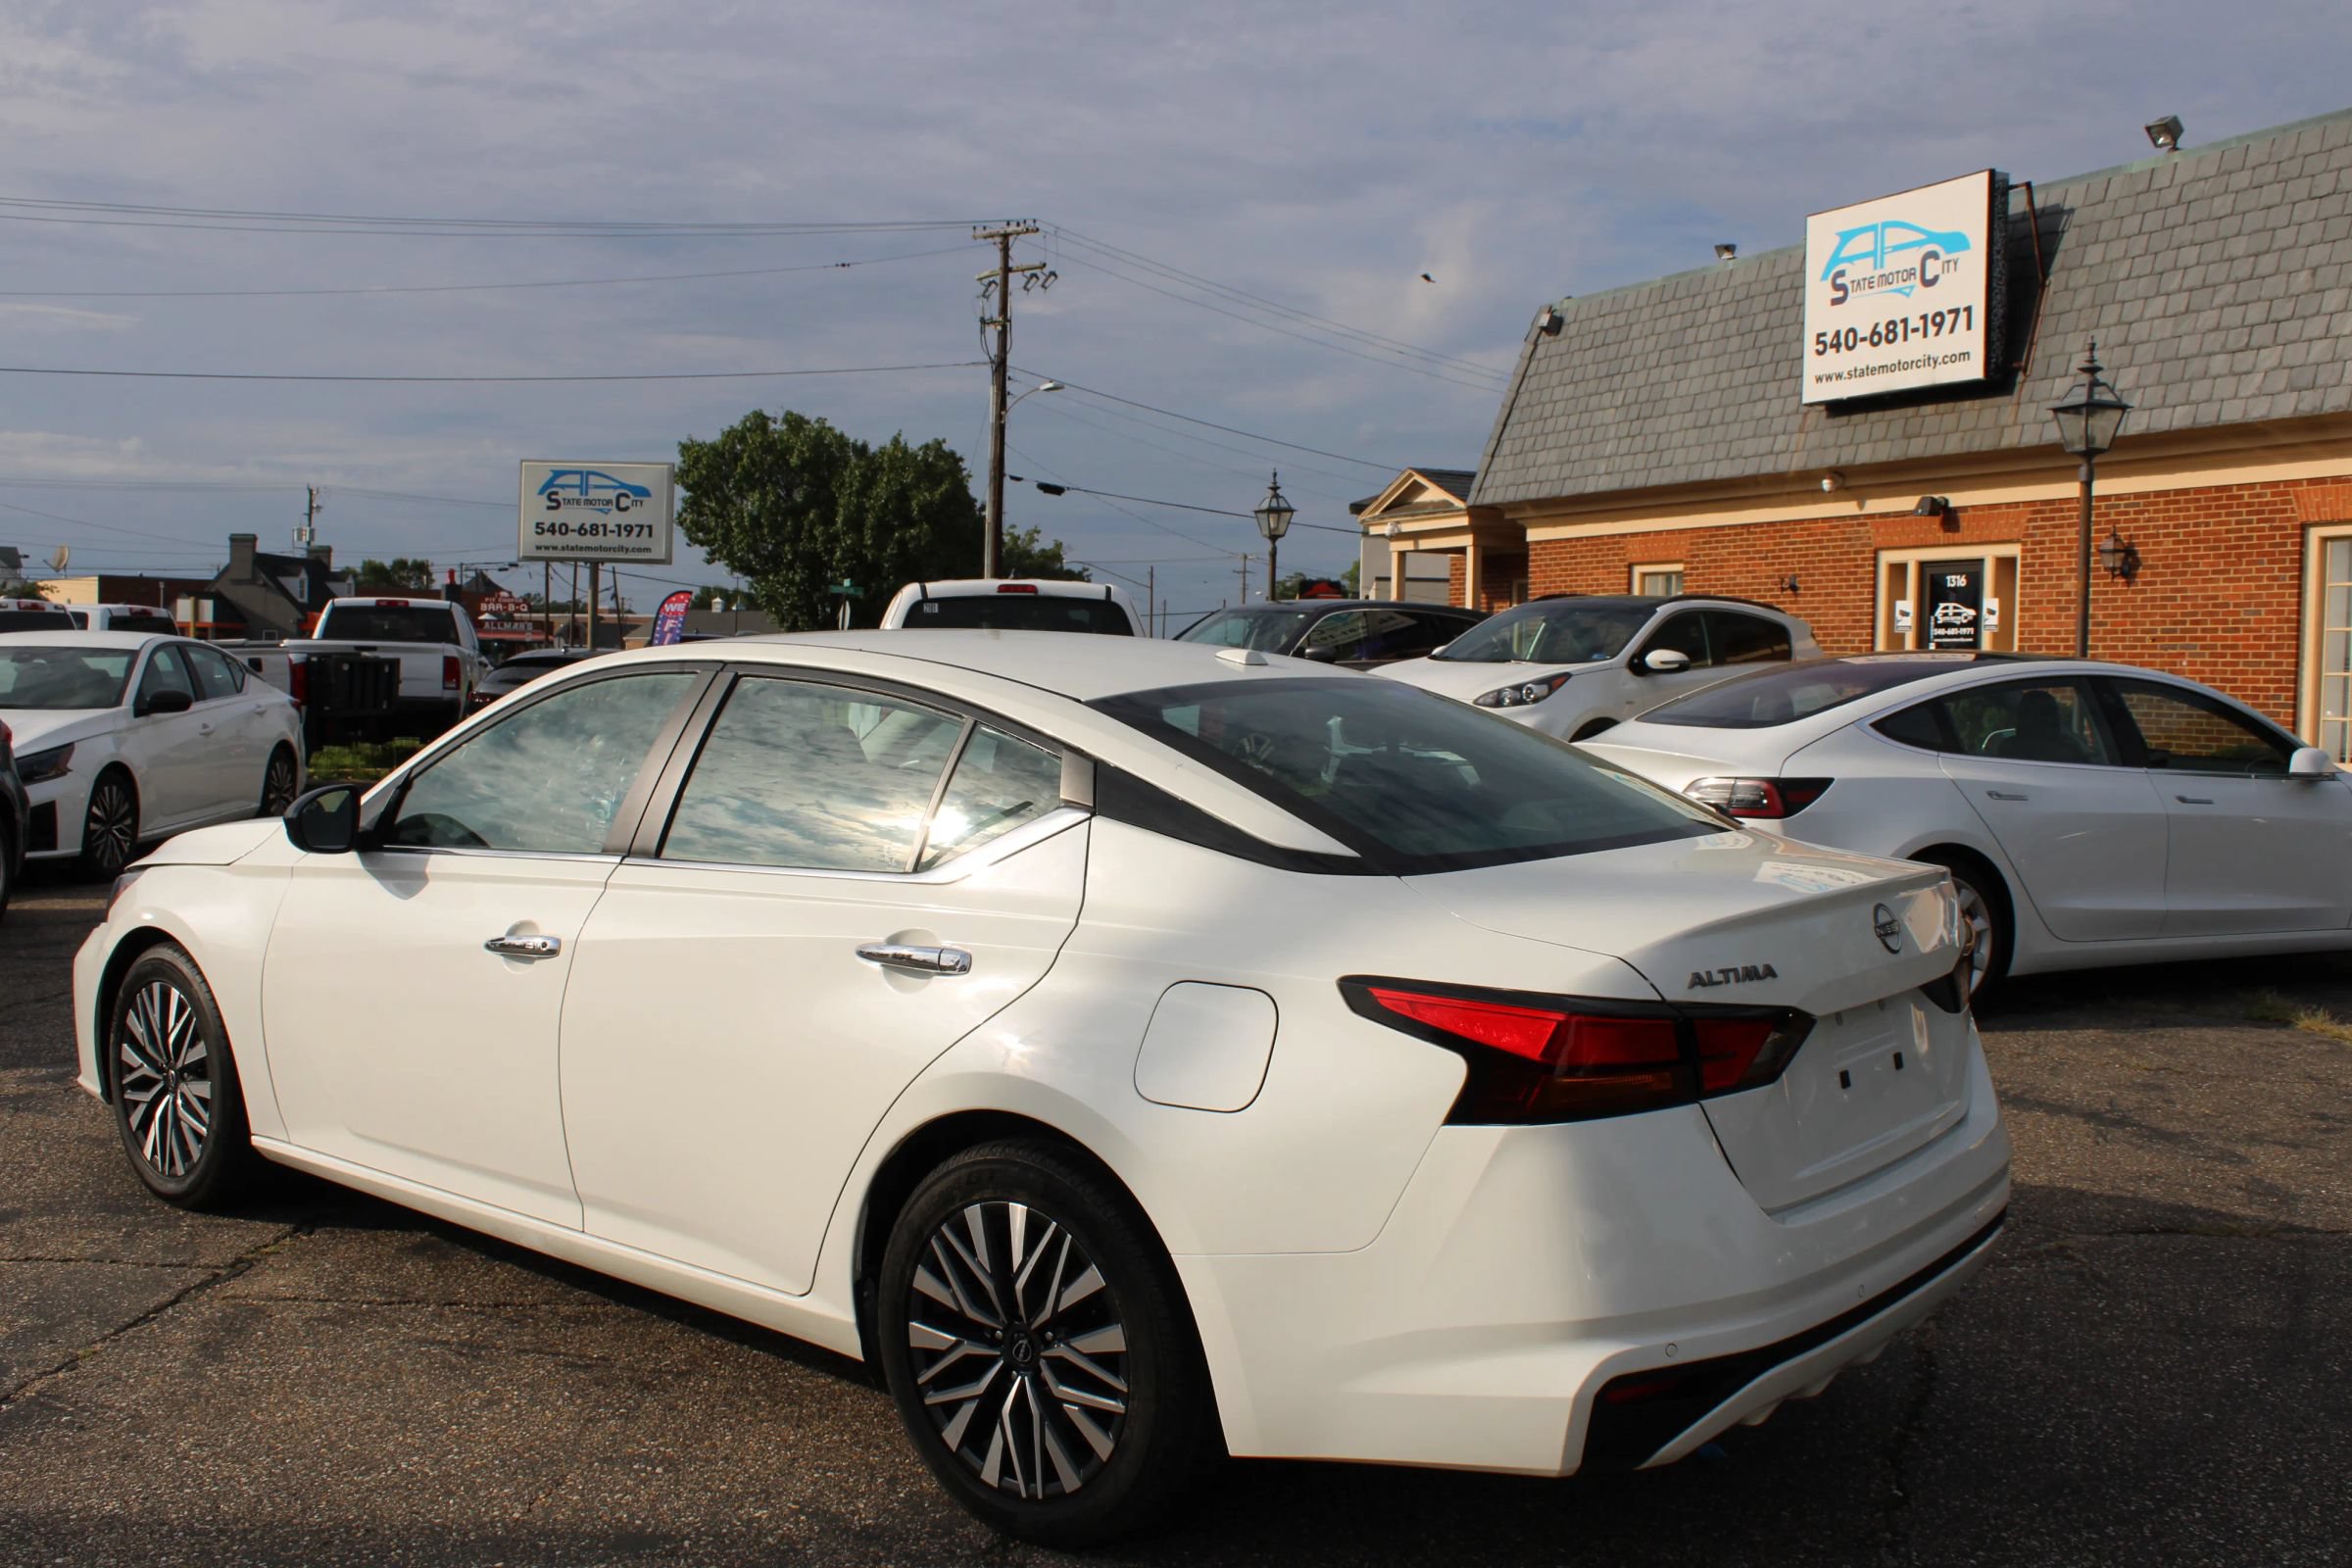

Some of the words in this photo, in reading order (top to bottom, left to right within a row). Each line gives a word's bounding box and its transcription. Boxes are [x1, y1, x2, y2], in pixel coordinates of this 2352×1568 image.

[1830, 270, 1876, 306] STATE
[1878, 267, 1917, 288] MOTOR
[1920, 250, 1960, 288] CITY
[1814, 305, 1974, 357] 540-681-1971
[1814, 350, 1971, 384] www.statemotorcity.com
[546, 491, 581, 511] STATE
[583, 498, 613, 508] MOTOR
[615, 492, 644, 513] CITY
[534, 522, 654, 538] 540-681-1971
[535, 544, 652, 555] www.statemotorcity.com
[1945, 574, 1967, 588] 1316
[664, 603, 686, 612] WE
[484, 621, 533, 630] ALLMAN'S
[1688, 963, 1779, 989] ALTIMA
